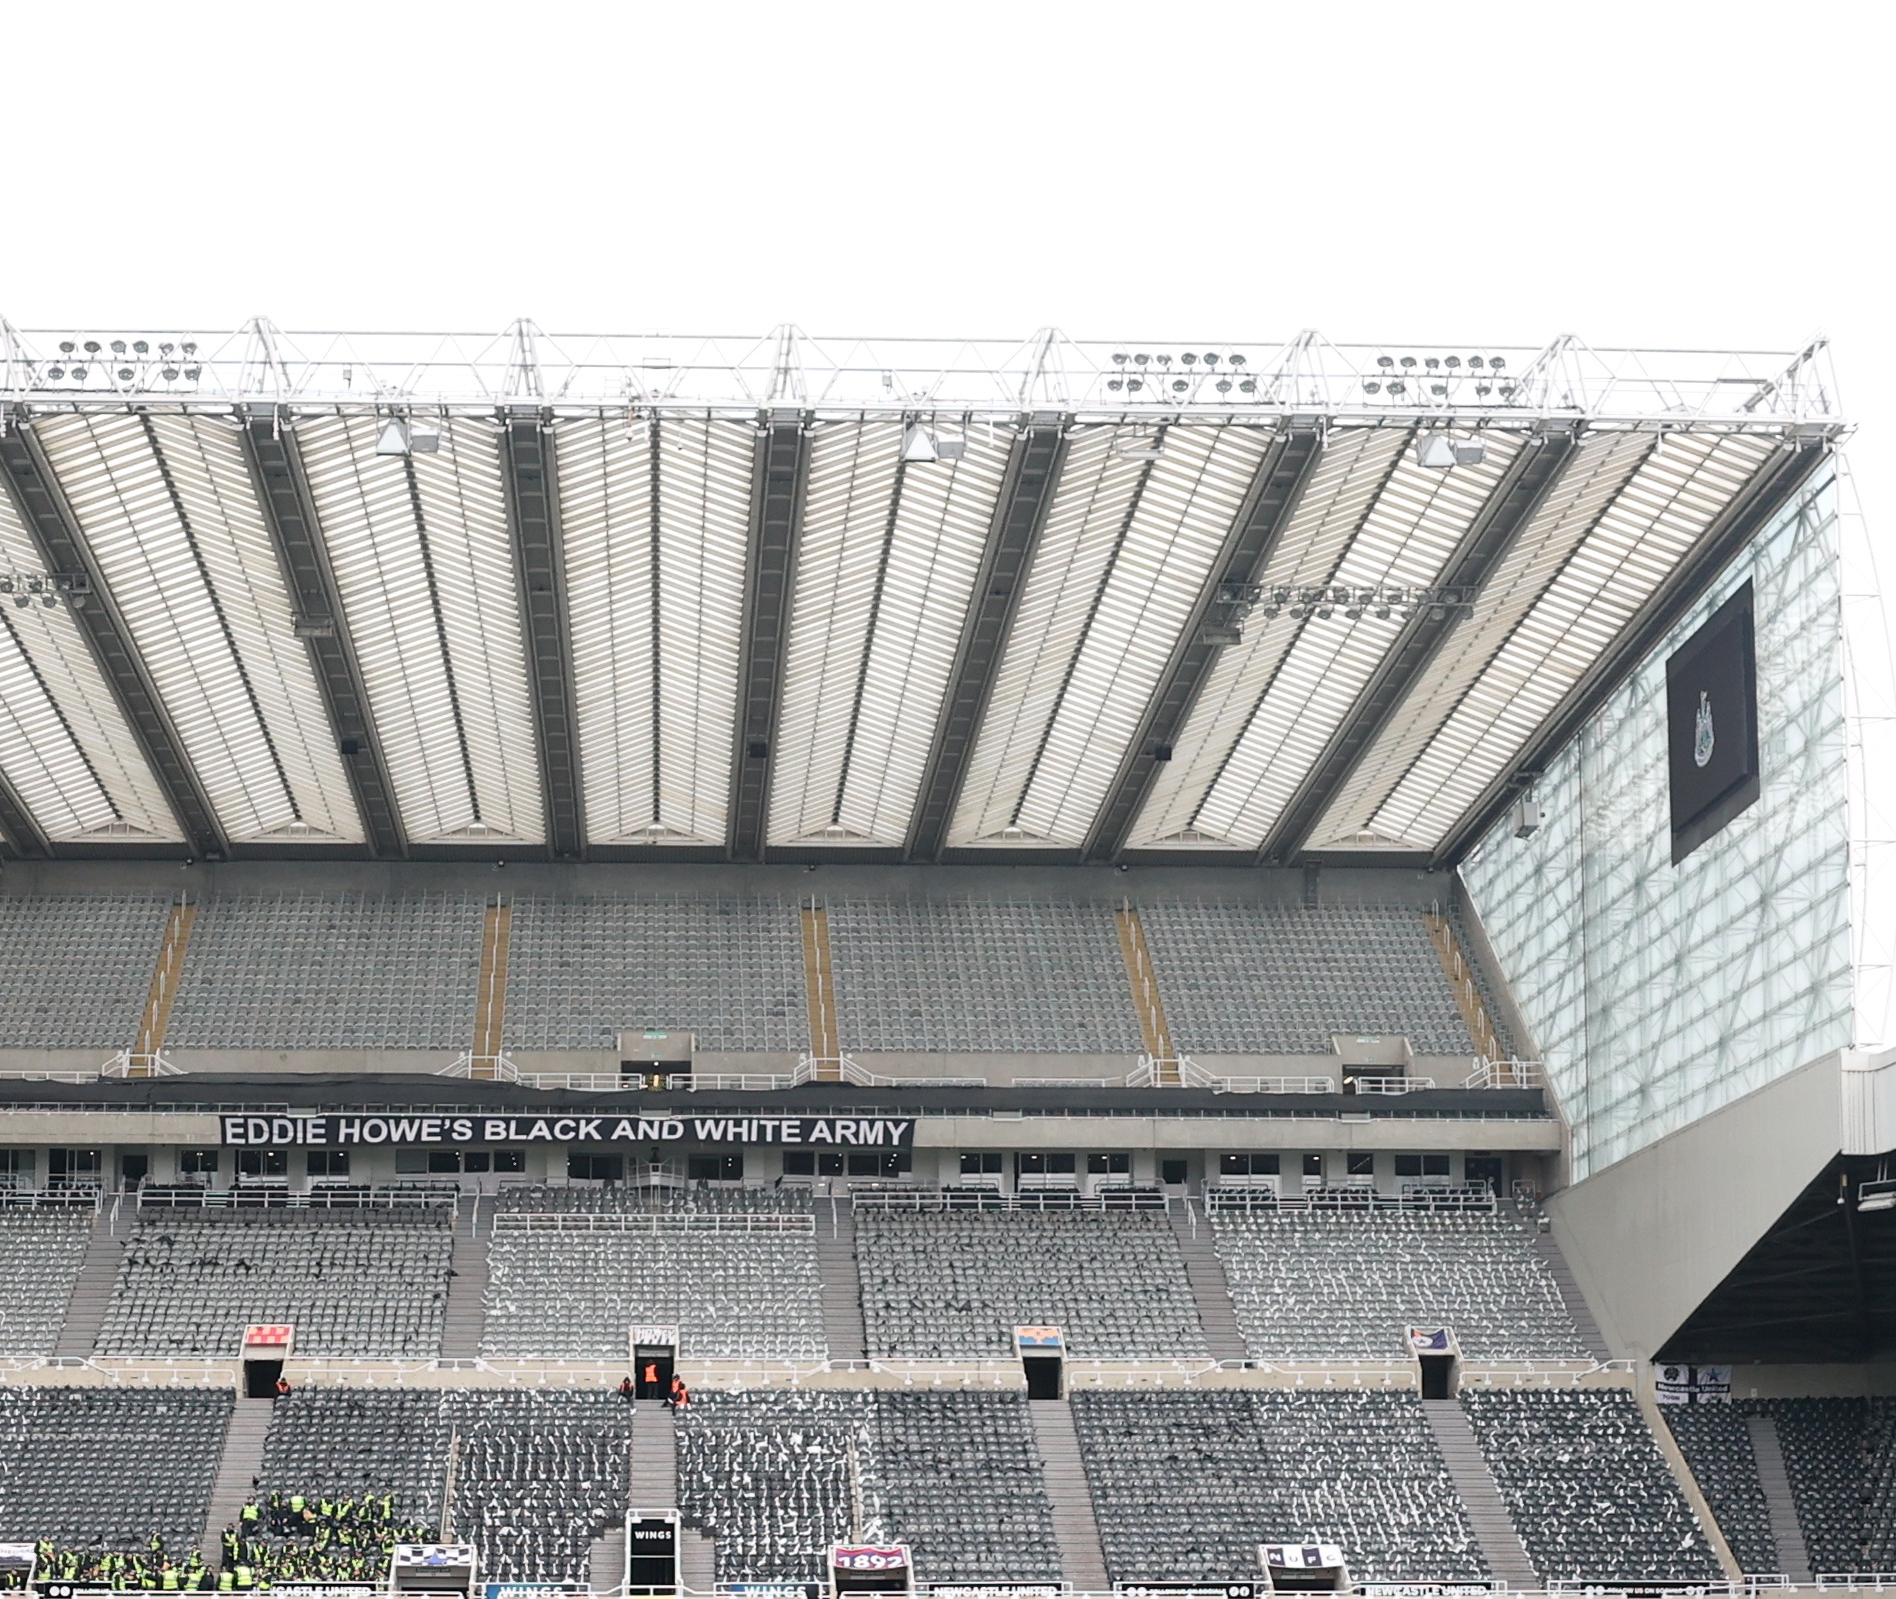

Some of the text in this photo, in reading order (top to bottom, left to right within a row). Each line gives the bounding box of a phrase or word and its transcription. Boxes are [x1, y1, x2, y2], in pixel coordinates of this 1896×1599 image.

[226, 1116, 911, 1147] EDDIE HOWE'S BLACK AND WHITE ARMY
[635, 1530, 672, 1539] WINGS
[838, 1554, 903, 1568] 1892
[500, 1586, 562, 1598] WINGS
[744, 1586, 807, 1598] WINGS
[933, 1586, 1057, 1597] NEWCASTLE UNITED
[1365, 1585, 1487, 1596] NEWCASTLE UNITED
